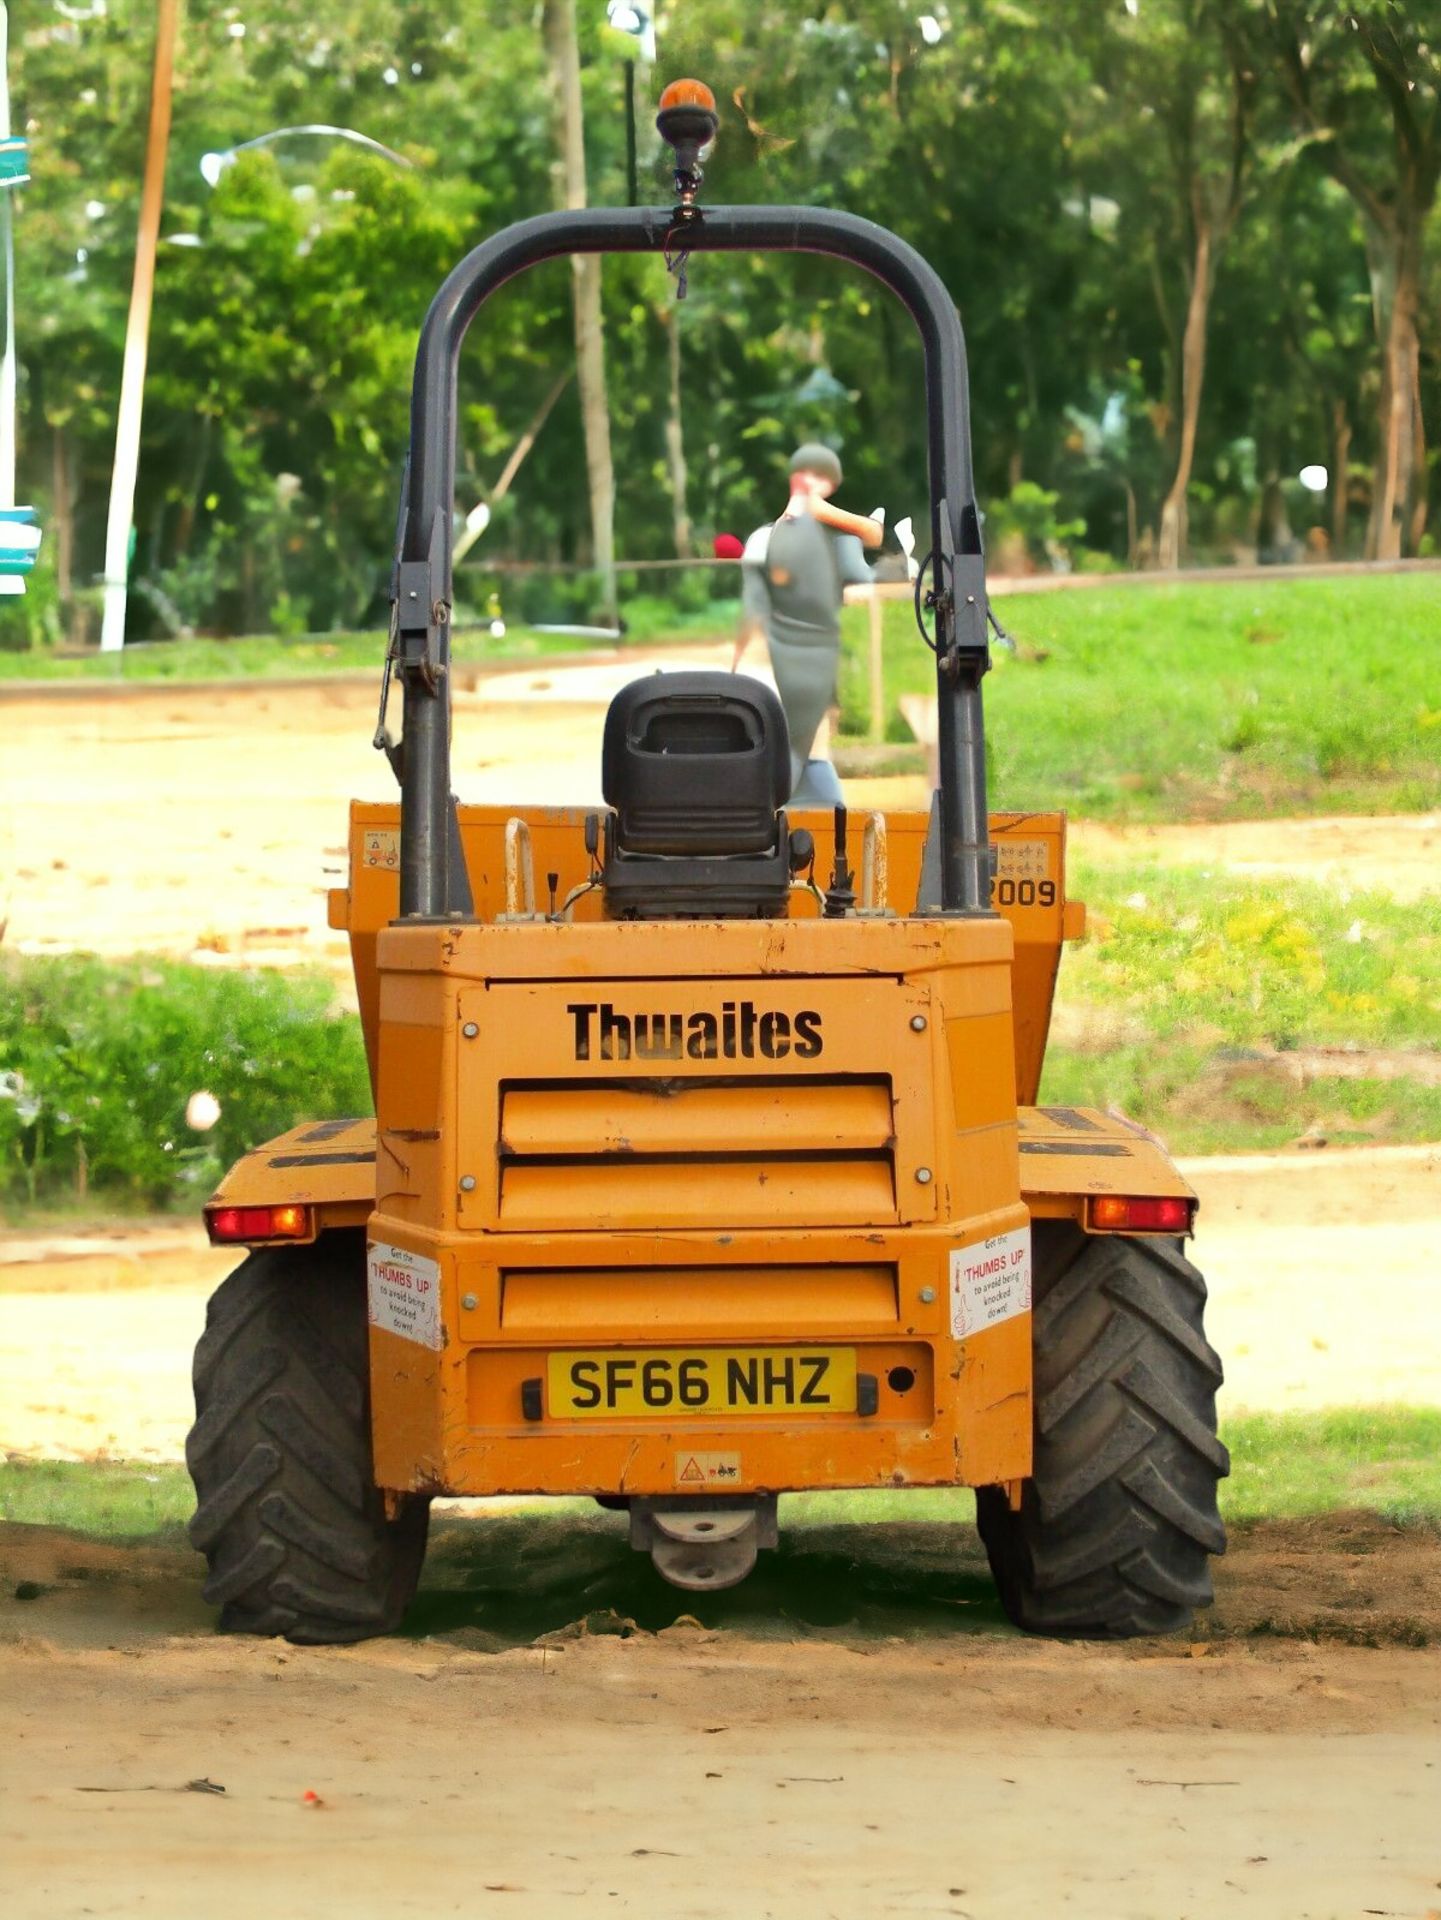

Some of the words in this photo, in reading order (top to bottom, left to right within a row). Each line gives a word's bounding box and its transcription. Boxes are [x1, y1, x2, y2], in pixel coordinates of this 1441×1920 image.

[567, 1002, 823, 1061] Thwaites
[391, 1248, 402, 1259] Get
[985, 1239, 996, 1250] Get
[974, 1286, 982, 1295] to
[983, 1278, 1002, 1293] avoid
[1002, 1271, 1020, 1287] being
[380, 1286, 388, 1295] to
[388, 1289, 407, 1303] avoid
[408, 1294, 426, 1312] being
[983, 1288, 1011, 1306] knocked
[389, 1302, 417, 1320] knocked
[570, 1359, 709, 1408] SF66
[728, 1357, 830, 1405] NHZ
